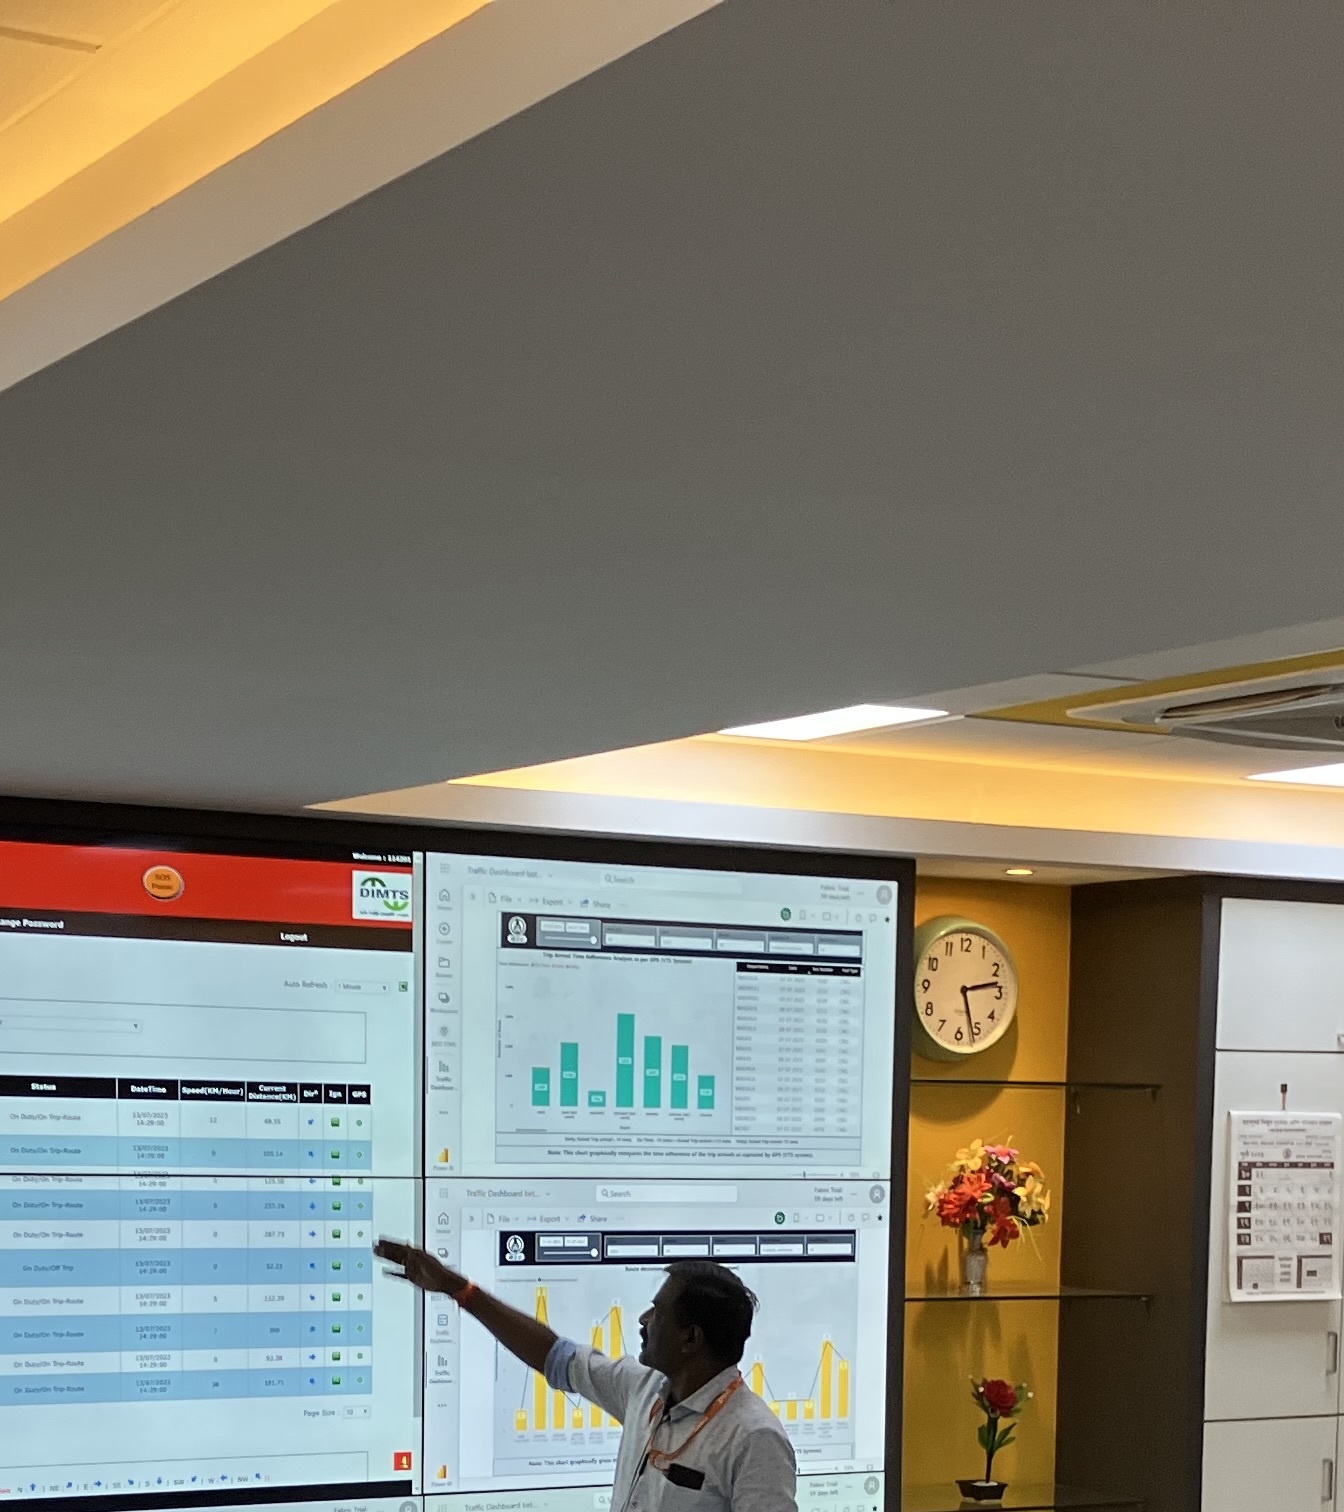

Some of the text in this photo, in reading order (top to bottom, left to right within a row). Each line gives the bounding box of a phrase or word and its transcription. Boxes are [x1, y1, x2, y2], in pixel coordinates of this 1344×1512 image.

[613, 875, 635, 885] Search
[360, 888, 409, 900] DIMTS
[22, 918, 65, 929] Password
[280, 932, 309, 943] Logout
[945, 942, 954, 957] 11
[960, 937, 972, 953] 12
[982, 945, 986, 960] 1
[928, 956, 939, 972] 10
[992, 962, 1000, 978] 2
[922, 978, 931, 994] 9
[994, 985, 1003, 1000] 3
[925, 1001, 934, 1017] 8
[988, 1009, 995, 1022] 4
[938, 1020, 947, 1033] 7
[973, 1022, 982, 1036] 5
[954, 1026, 964, 1041] 6
[30, 1082, 57, 1091] Status
[130, 1084, 167, 1094] DateTime
[258, 1084, 287, 1093] Current
[248, 1092, 297, 1102] Distance(KM)
[466, 1190, 524, 1198] Traffic Dashboard
[610, 1190, 631, 1198] Search
[498, 1215, 510, 1223] File
[540, 1216, 561, 1225] Export
[590, 1215, 608, 1223] Share
[304, 1409, 336, 1418] Page Size
[465, 1502, 521, 1512] Traffic Dashboard
